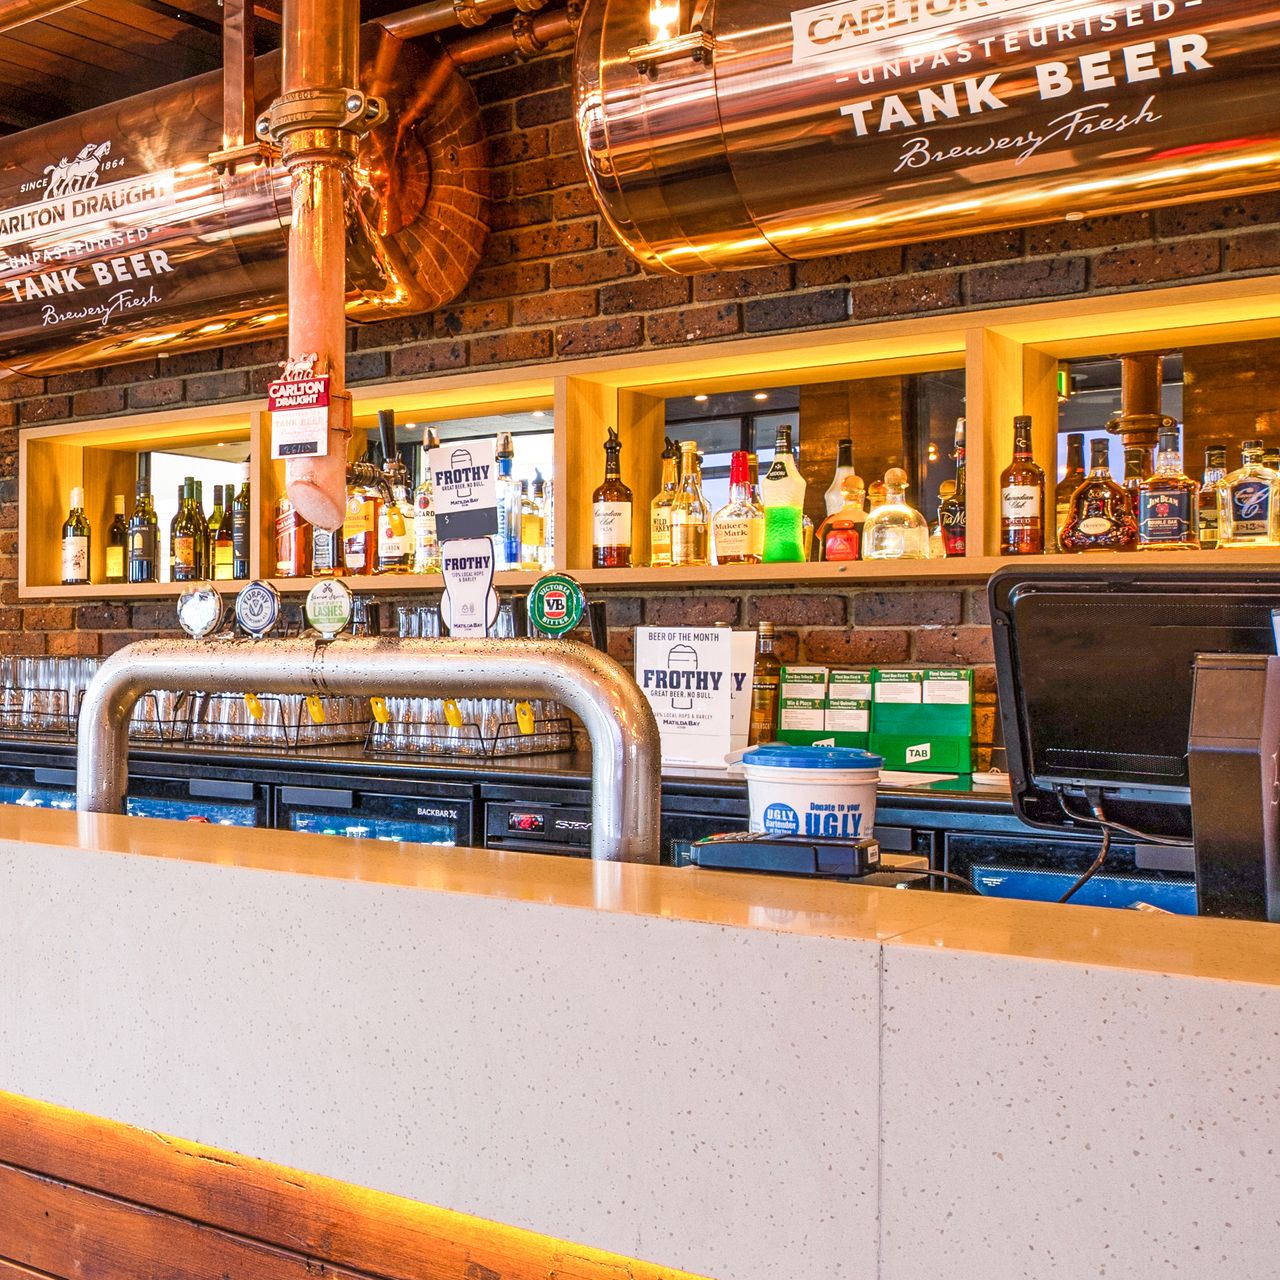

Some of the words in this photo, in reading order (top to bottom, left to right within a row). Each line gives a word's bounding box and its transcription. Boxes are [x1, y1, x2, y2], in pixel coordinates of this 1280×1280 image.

[840, 72, 1007, 137] TANK
[1038, 33, 1214, 100] BEER
[893, 132, 1048, 174] Brewery
[1047, 95, 1163, 143] Fresh
[101, 157, 125, 171] 1864
[20, 178, 49, 193] SINCE
[5, 267, 86, 303] TANK
[92, 250, 175, 286] BEER
[42, 304, 113, 327] Brewery
[108, 286, 162, 313] Fresh
[269, 381, 325, 398] CARLTON
[275, 394, 319, 407] DRAUGHT
[435, 465, 490, 487] FROTHY
[1147, 497, 1160, 508] JIM
[1160, 495, 1178, 506] BEAM
[445, 556, 491, 571] FROTHY
[540, 583, 571, 596] VICTORIA
[243, 590, 270, 605] FURPHY
[546, 598, 565, 611] VB
[313, 605, 344, 618] LASHES
[542, 616, 570, 626] BITTER
[649, 632, 666, 641] BEER
[668, 633, 677, 641] OF
[678, 633, 691, 641] THE
[693, 633, 719, 642] MONTH
[643, 670, 722, 691] FROTHY
[651, 690, 668, 698] GREAT
[909, 748, 928, 758] TAB
[810, 802, 835, 811] Donate
[838, 803, 845, 812] to
[847, 803, 860, 813] your
[766, 820, 796, 830] Bartender
